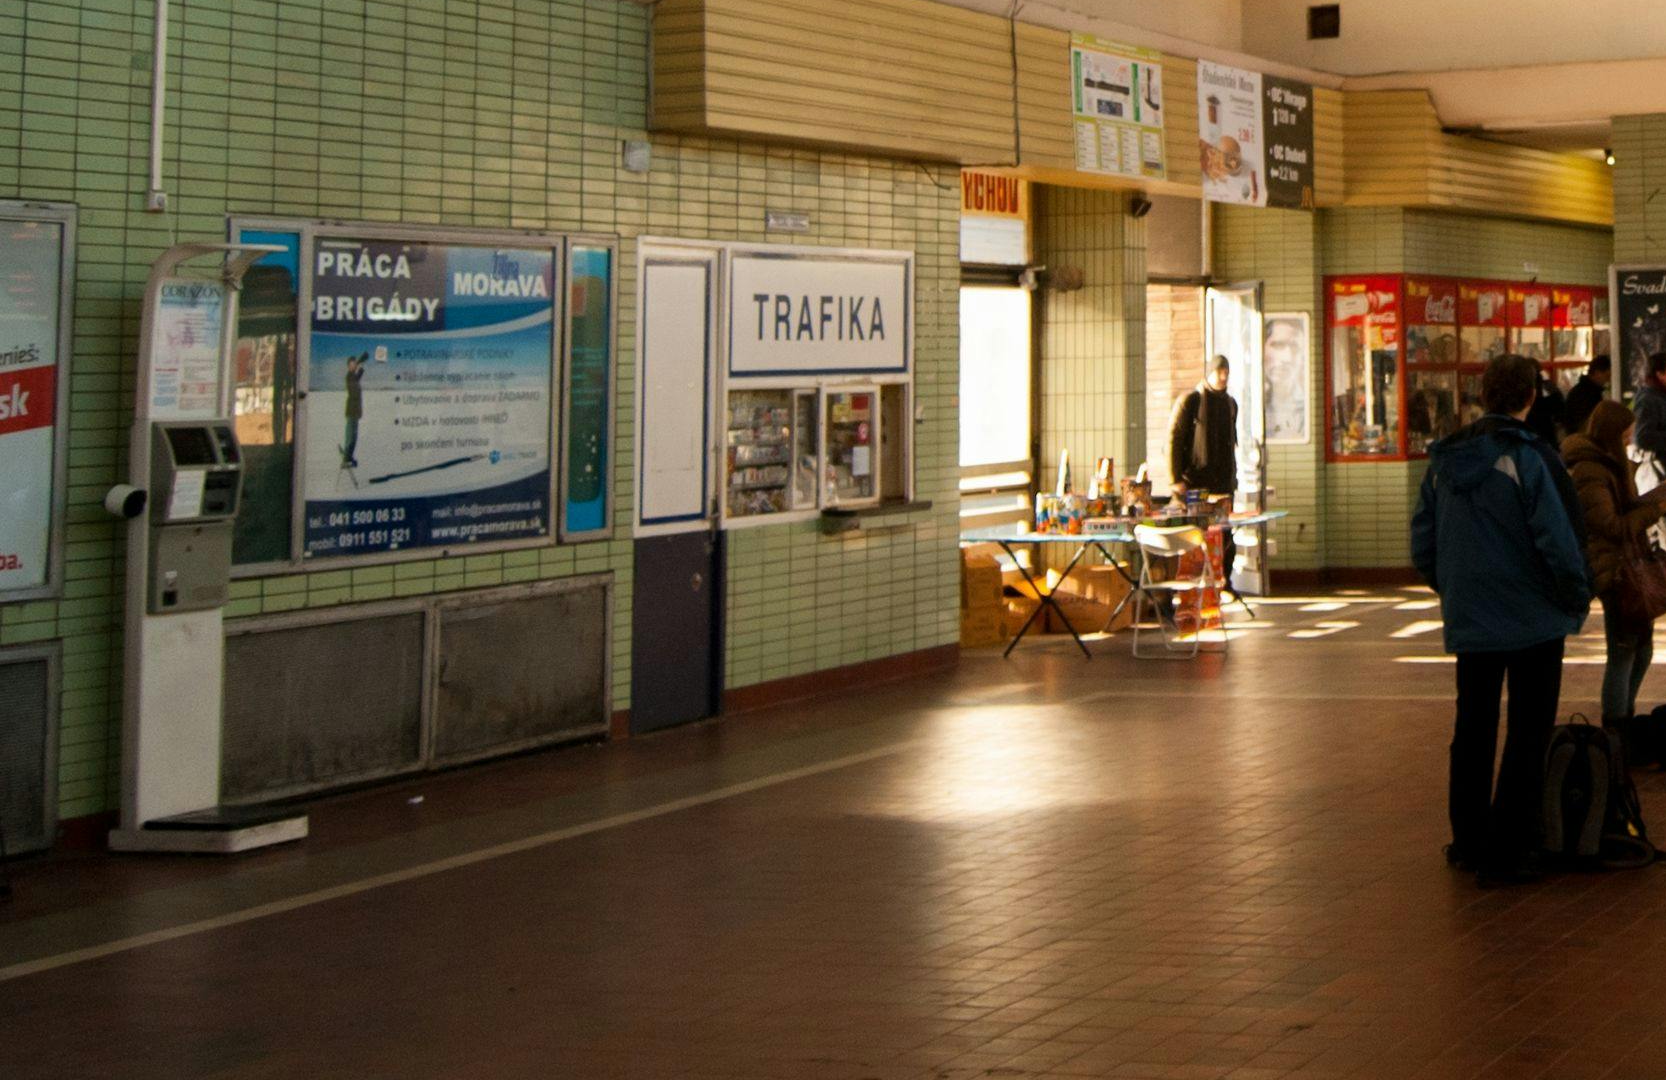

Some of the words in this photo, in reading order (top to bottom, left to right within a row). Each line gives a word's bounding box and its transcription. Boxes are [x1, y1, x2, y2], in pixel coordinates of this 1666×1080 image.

[318, 248, 411, 279] PRÁCA
[453, 272, 548, 298] MORAVA
[316, 292, 440, 321] BRIGÁDY
[753, 294, 885, 341] TRAFIKA
[329, 512, 350, 526] 041
[353, 510, 373, 525] 500
[391, 507, 406, 520] 33
[431, 516, 542, 539] www.pracamorava.sk
[339, 533, 366, 548] 0911
[368, 530, 388, 544] 551
[390, 528, 411, 543] 521
